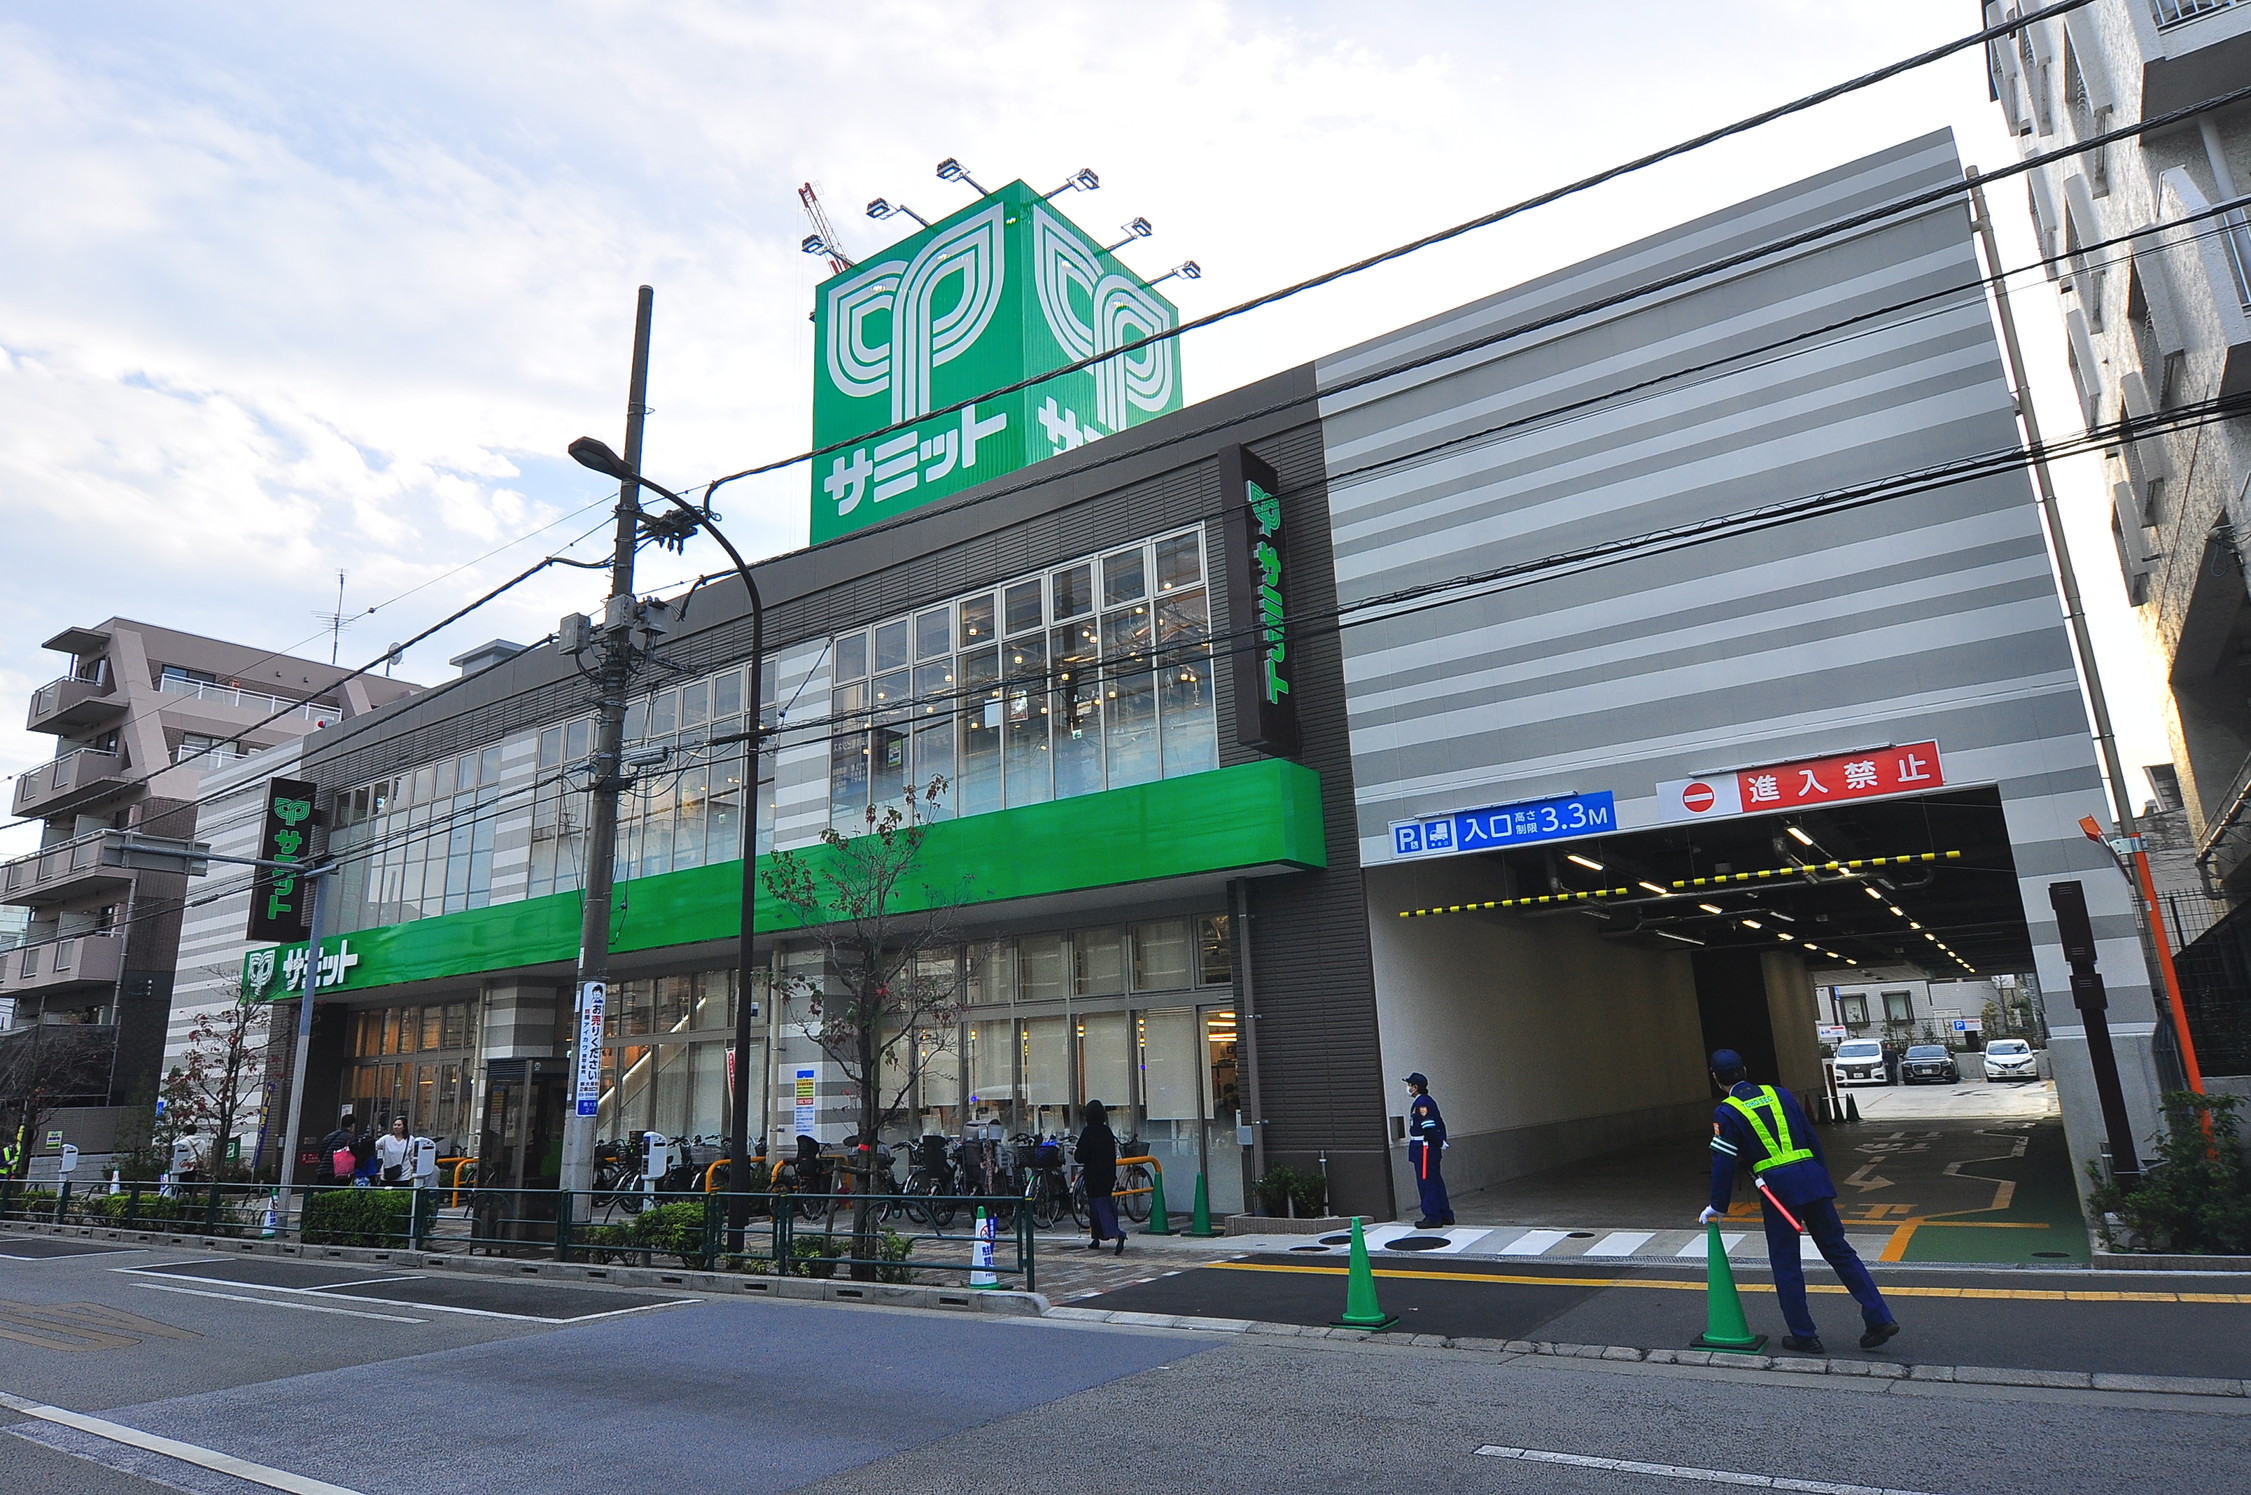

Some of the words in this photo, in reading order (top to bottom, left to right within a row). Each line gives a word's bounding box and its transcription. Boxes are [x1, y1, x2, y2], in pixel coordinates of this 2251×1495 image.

[824, 404, 1007, 516] サミット
[1255, 541, 1289, 705] サミット
[1747, 754, 1931, 803] 進入禁止
[1464, 814, 1513, 842] 入口
[1514, 810, 1536, 823] 高さ
[1515, 823, 1539, 835] 制限
[1540, 803, 1608, 832] 3.3M
[1399, 828, 1415, 851] P
[1955, 1021, 1963, 1030] P
[588, 1005, 602, 1080] お売りください
